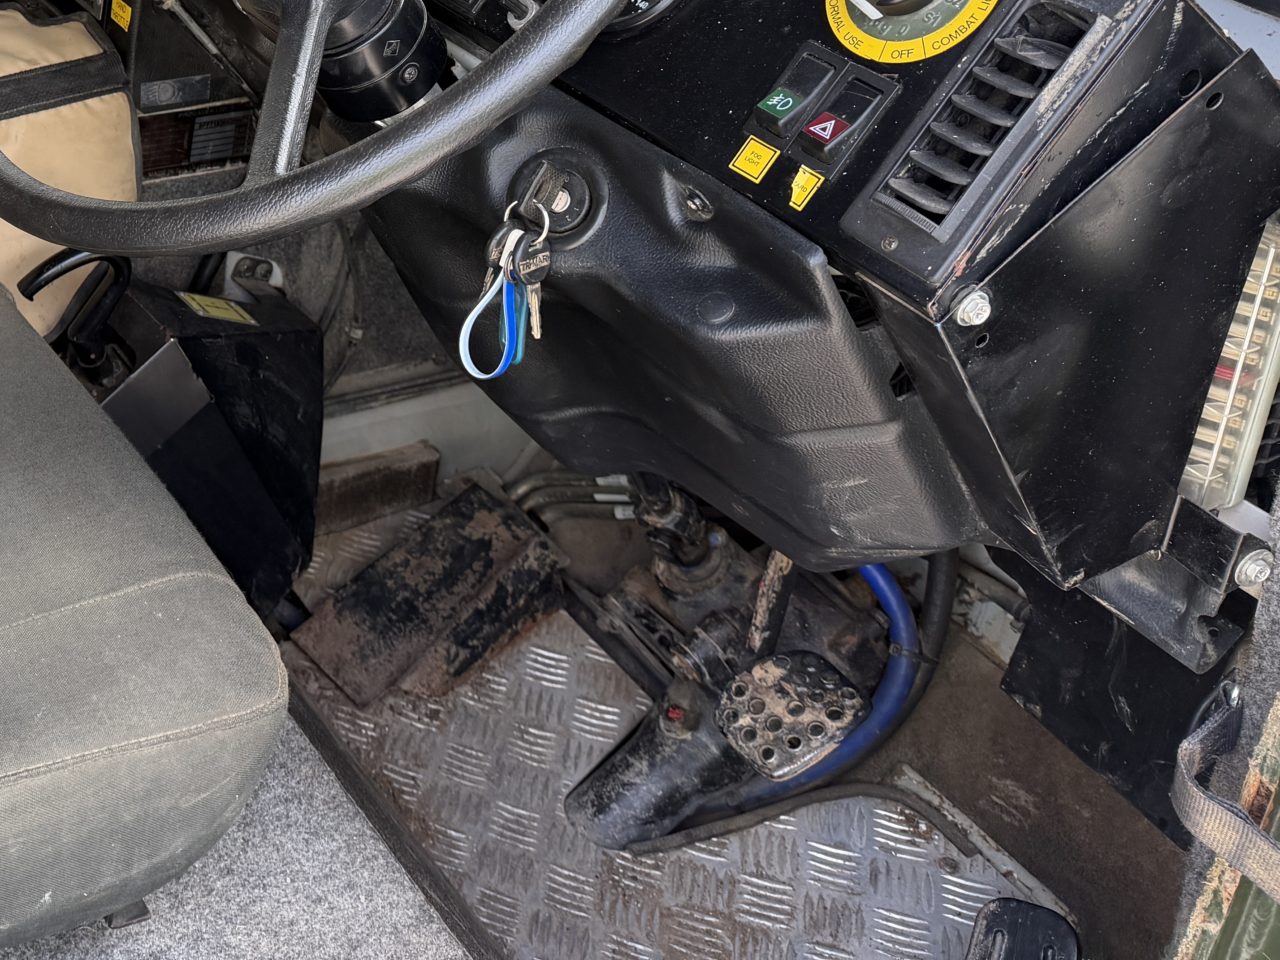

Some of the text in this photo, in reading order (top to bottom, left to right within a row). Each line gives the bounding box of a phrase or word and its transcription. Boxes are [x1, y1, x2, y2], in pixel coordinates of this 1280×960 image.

[931, 12, 979, 50] COMBAT
[843, 32, 864, 50] USE
[890, 48, 914, 59] OFF
[744, 155, 760, 167] LIGHT
[750, 150, 762, 160] FOG
